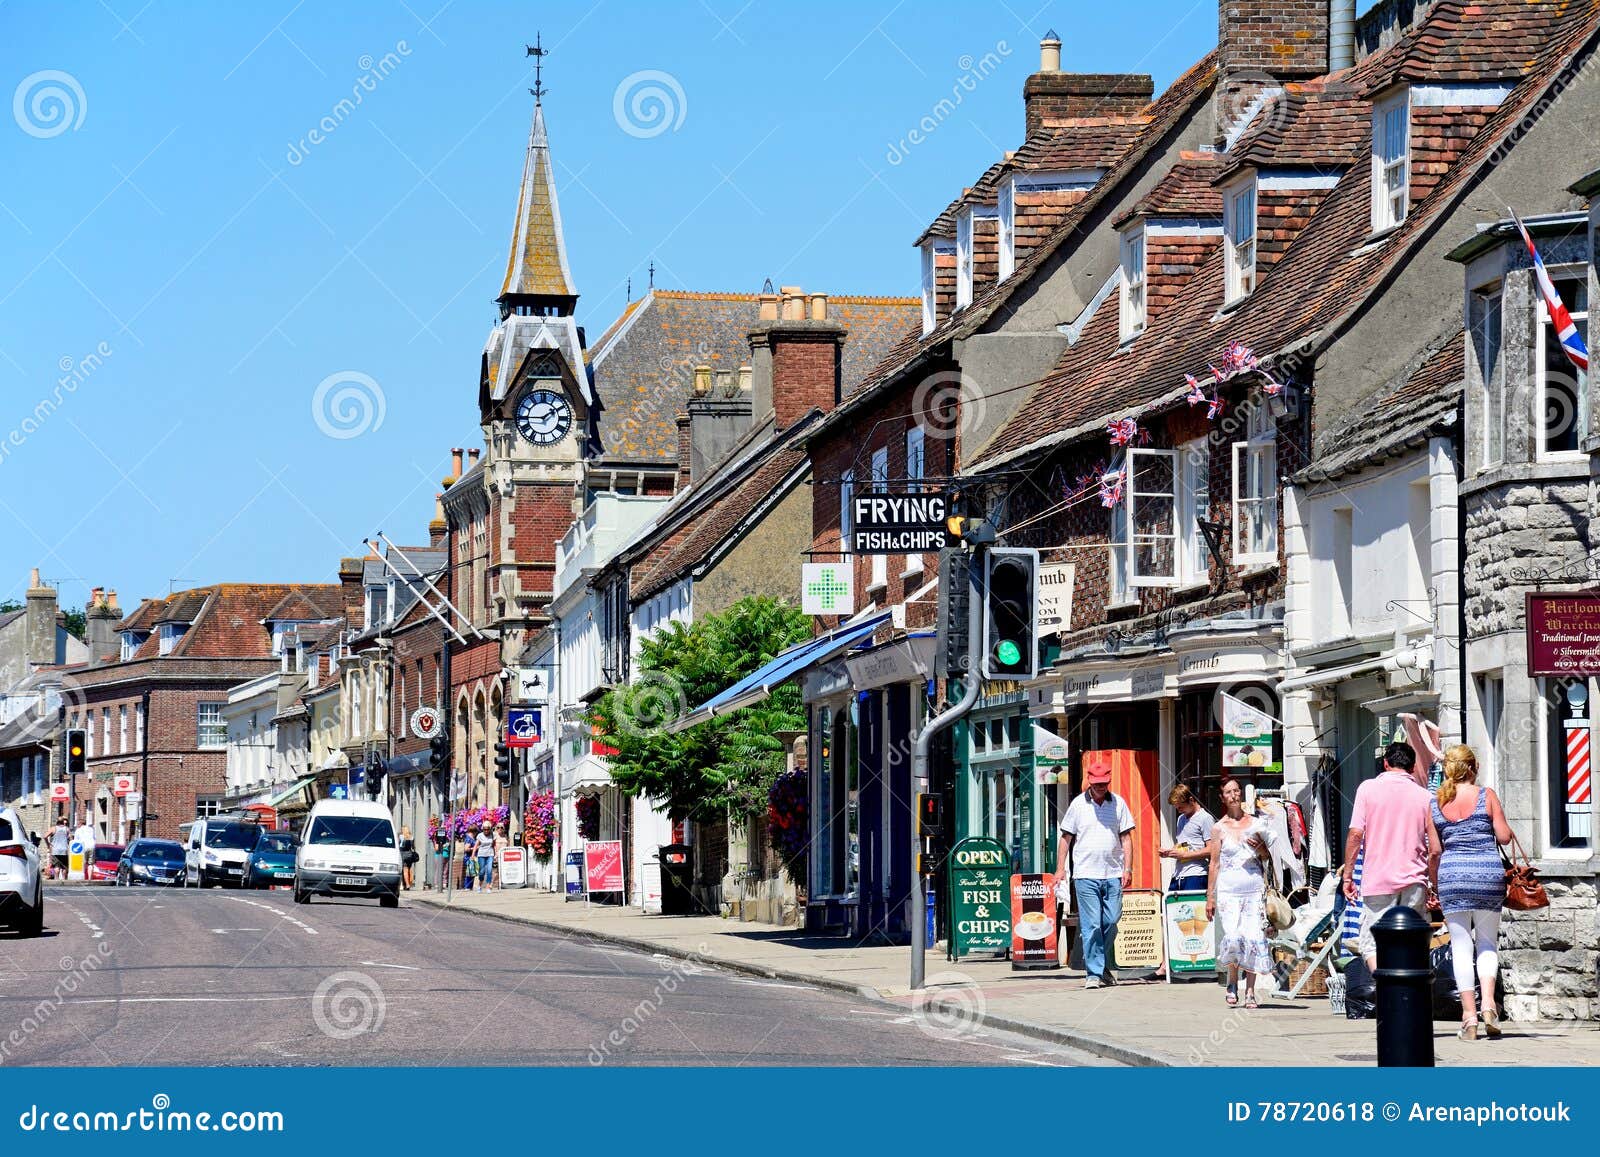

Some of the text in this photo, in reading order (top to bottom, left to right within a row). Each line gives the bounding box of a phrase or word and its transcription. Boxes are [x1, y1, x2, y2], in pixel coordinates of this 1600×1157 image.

[855, 498, 945, 523] FRYING
[1541, 632, 1582, 643] Traditional
[957, 850, 1002, 865] OPEN
[963, 890, 1001, 904] FISH
[975, 904, 990, 918] &
[958, 920, 1010, 934] CHIPS
